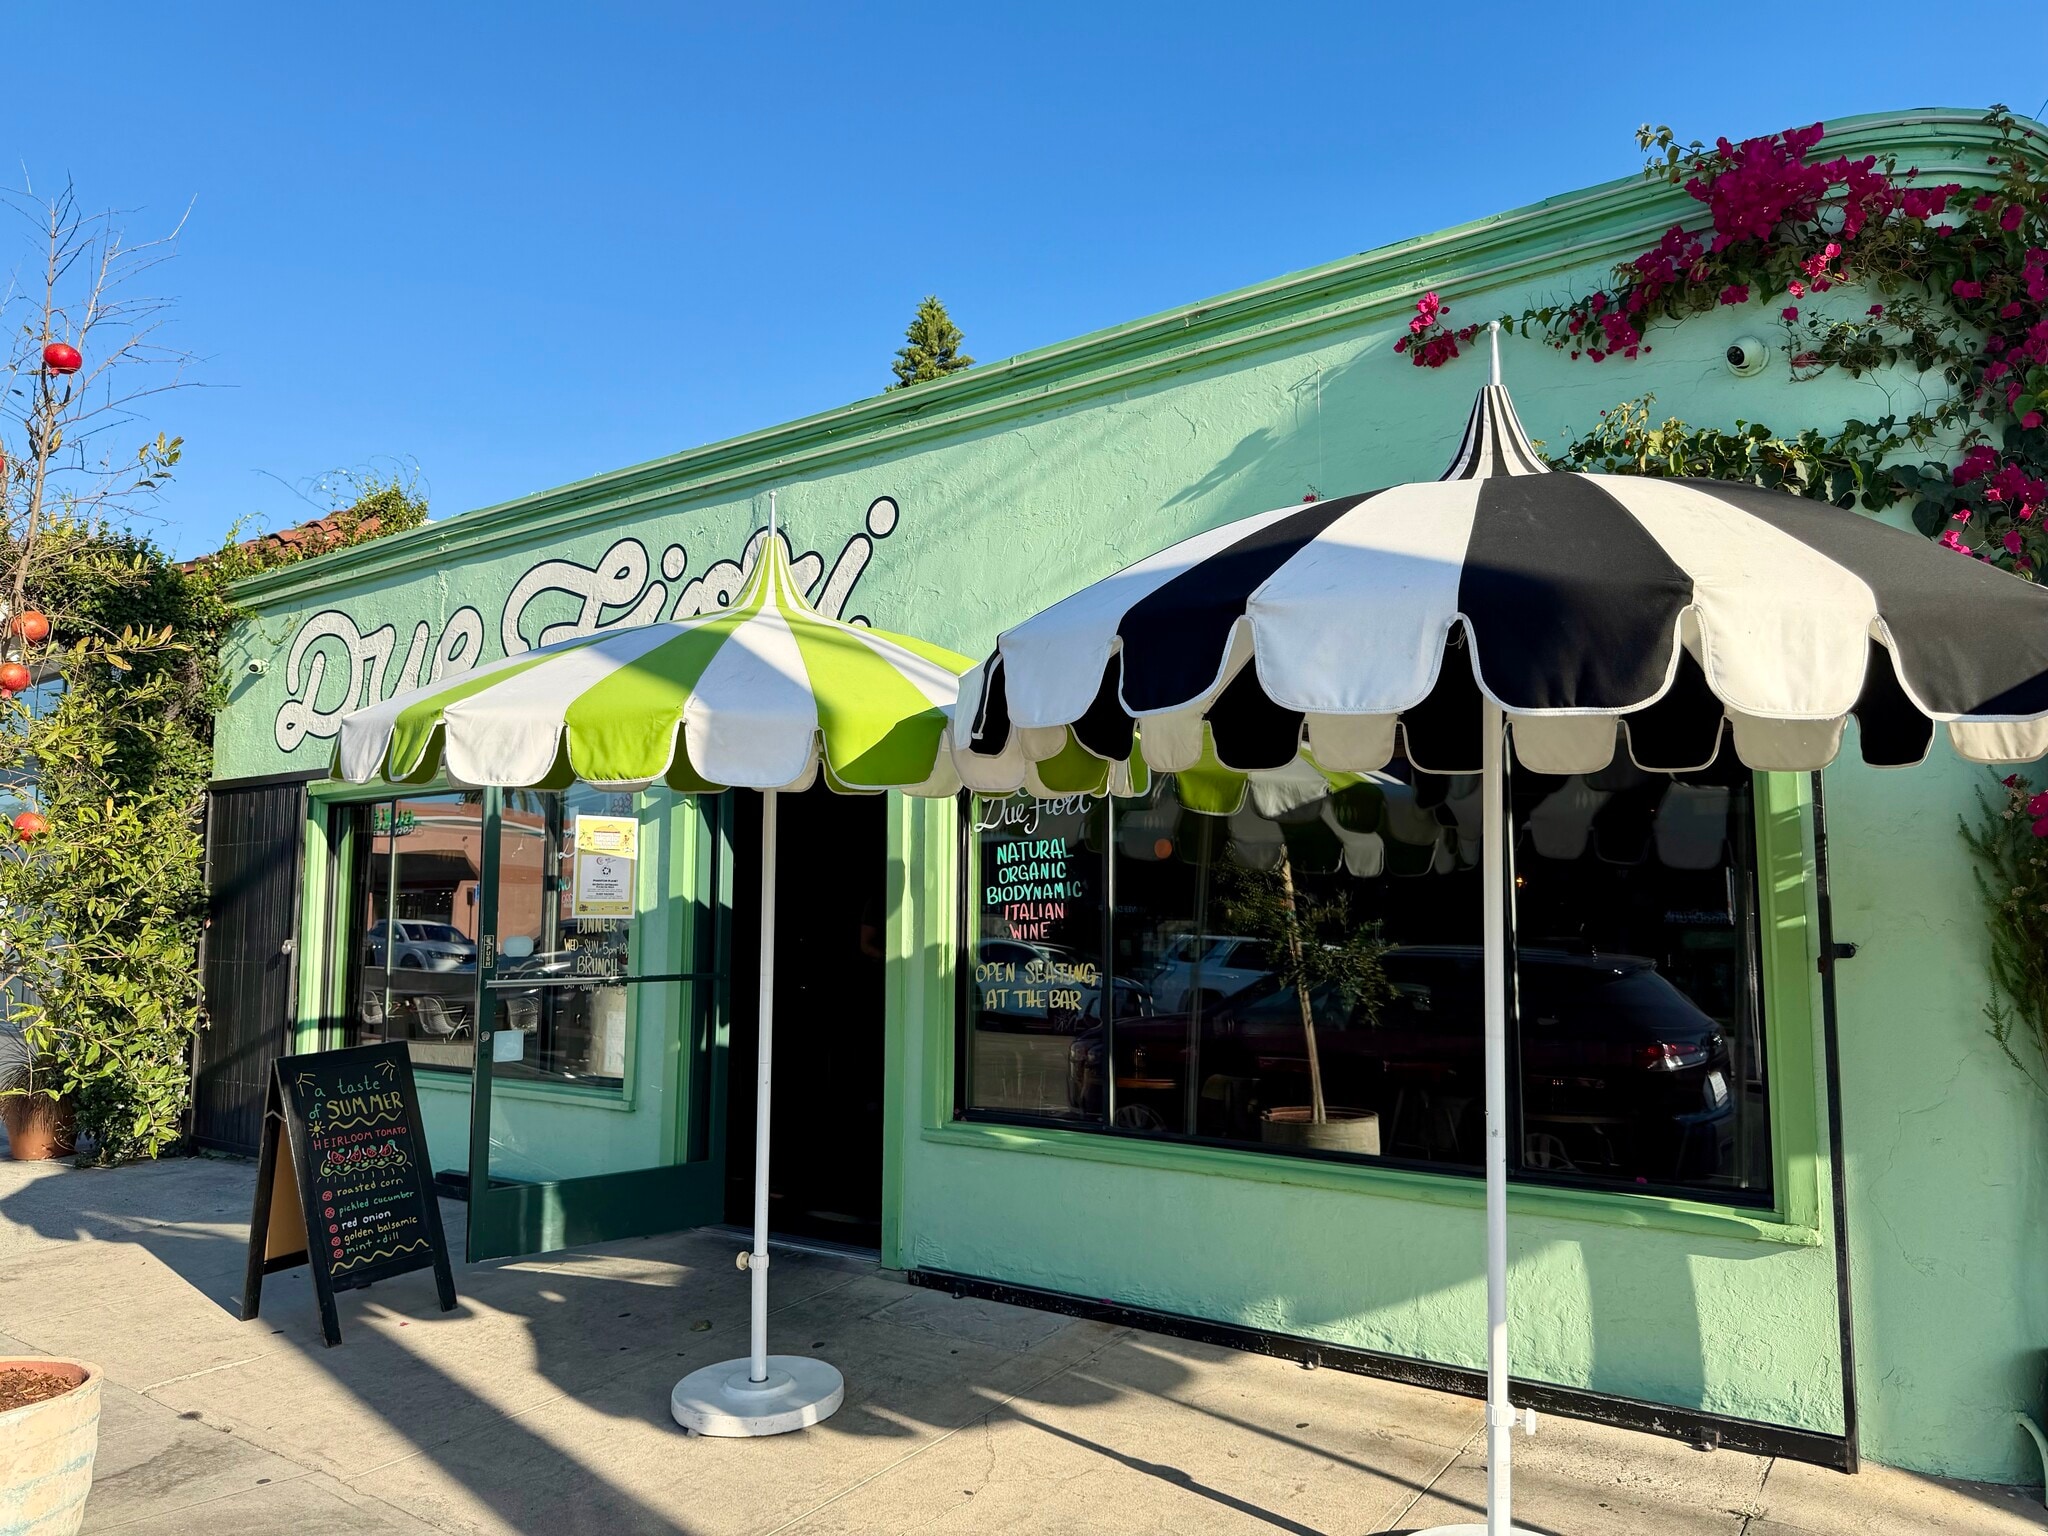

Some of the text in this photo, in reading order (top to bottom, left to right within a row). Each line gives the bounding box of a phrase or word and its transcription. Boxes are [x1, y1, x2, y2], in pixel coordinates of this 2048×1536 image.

[996, 837, 1074, 865] NATURAL
[998, 861, 1067, 885] ORGANIC
[986, 880, 1083, 905] BIODYNAMIC
[1004, 902, 1065, 921] ITALIAN
[577, 918, 618, 934] DINNER
[1008, 921, 1051, 940] WINE
[576, 955, 619, 977] BRUNCH
[975, 961, 1100, 987] OPEN SEATING
[985, 988, 1083, 1012] AT THE BAR
[314, 1074, 381, 1097] a taste
[309, 1091, 404, 1120] of SUMMER
[313, 1126, 407, 1150] HEIRLOOM TOMATO
[337, 1178, 404, 1197] roasted corn
[339, 1191, 415, 1218] pickled cucumber
[341, 1210, 391, 1230] red onion
[344, 1216, 418, 1246] golden balsamic
[382, 1231, 399, 1243] dill
